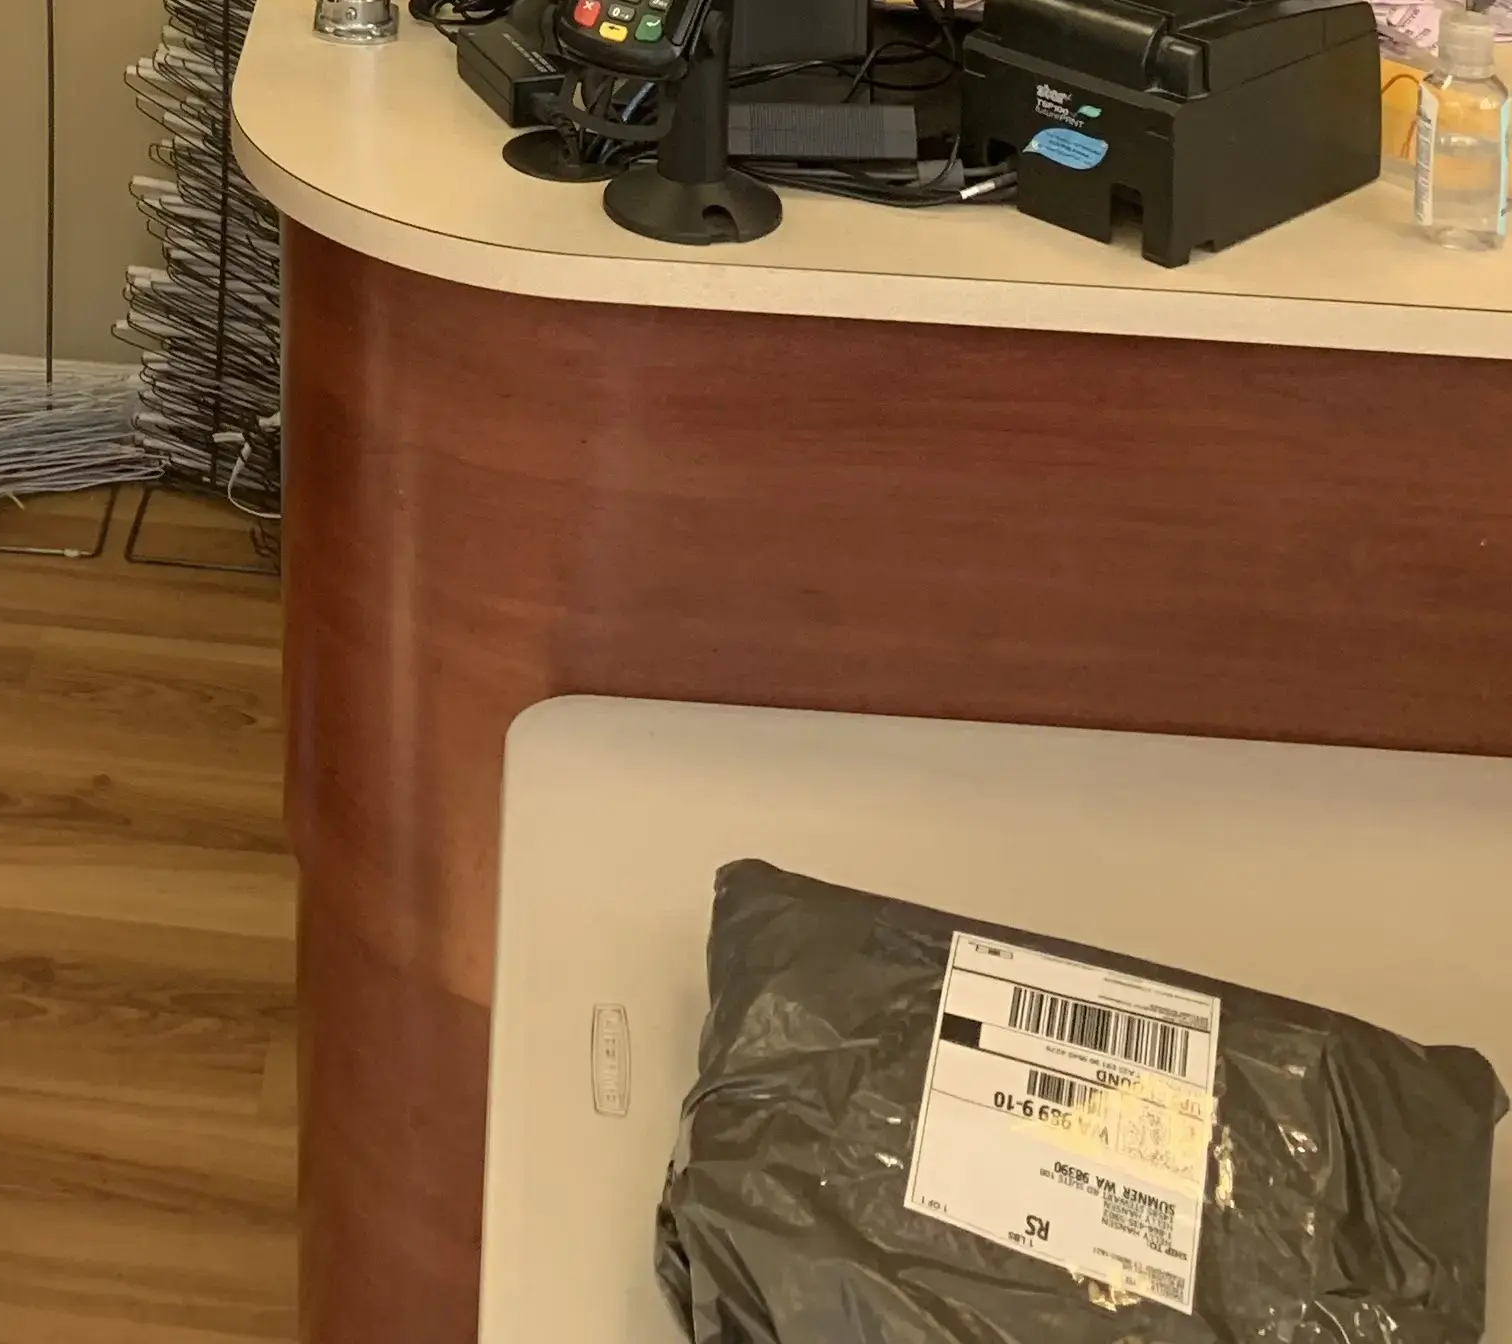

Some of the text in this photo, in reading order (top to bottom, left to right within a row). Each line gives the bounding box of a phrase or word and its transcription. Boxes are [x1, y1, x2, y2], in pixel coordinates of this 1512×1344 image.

[992, 1089, 1034, 1118] 9-10
[1053, 1160, 1175, 1214] SUMNER WA 98390
[1024, 1213, 1050, 1242] RS
[1164, 1246, 1187, 1261] SHIP
